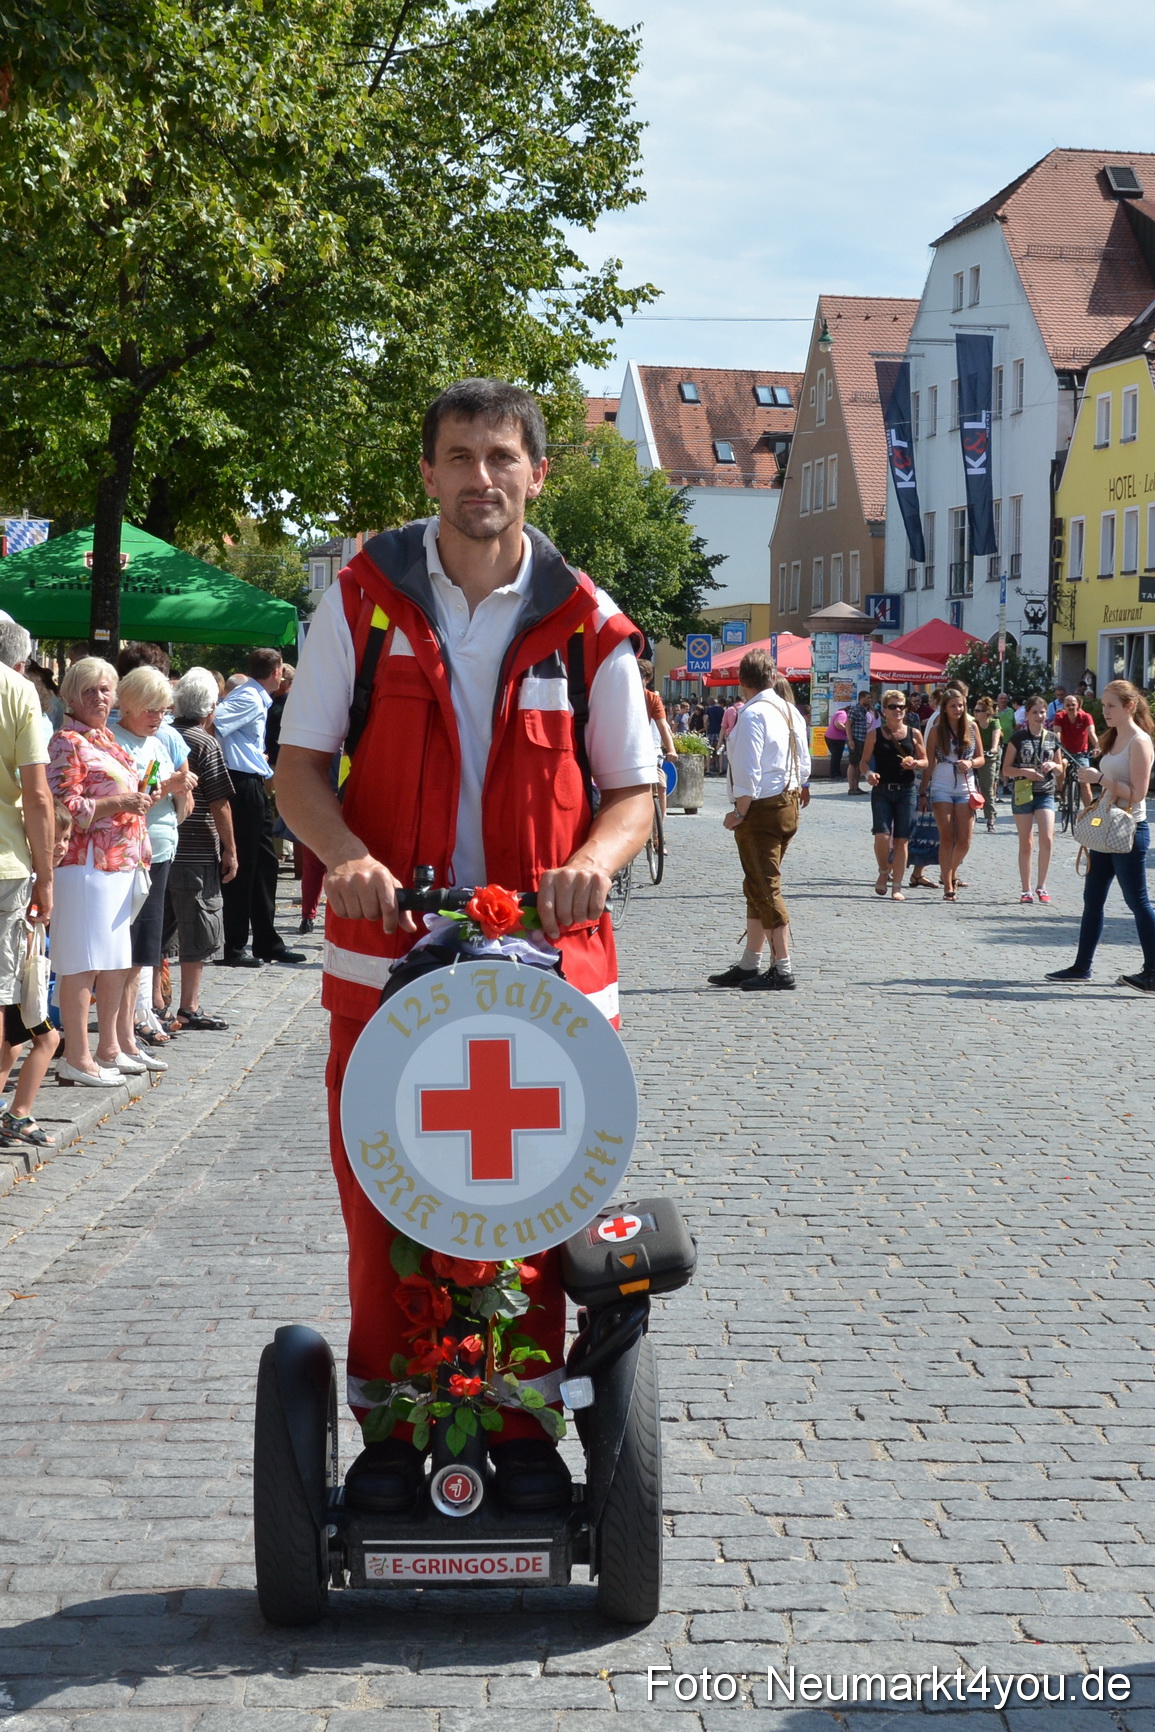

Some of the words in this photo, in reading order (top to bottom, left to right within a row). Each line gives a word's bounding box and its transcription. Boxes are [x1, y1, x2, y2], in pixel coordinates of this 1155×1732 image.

[1108, 474, 1137, 502] HOTEL
[1103, 605, 1144, 624] Restaurant
[689, 661, 710, 669] TAXI
[387, 983, 451, 1039] 125
[470, 968, 589, 1039] Jahre
[358, 1130, 443, 1230] BRK
[450, 1129, 624, 1248] Neumarkt
[392, 1557, 543, 1575] E-GRINGOS.DE
